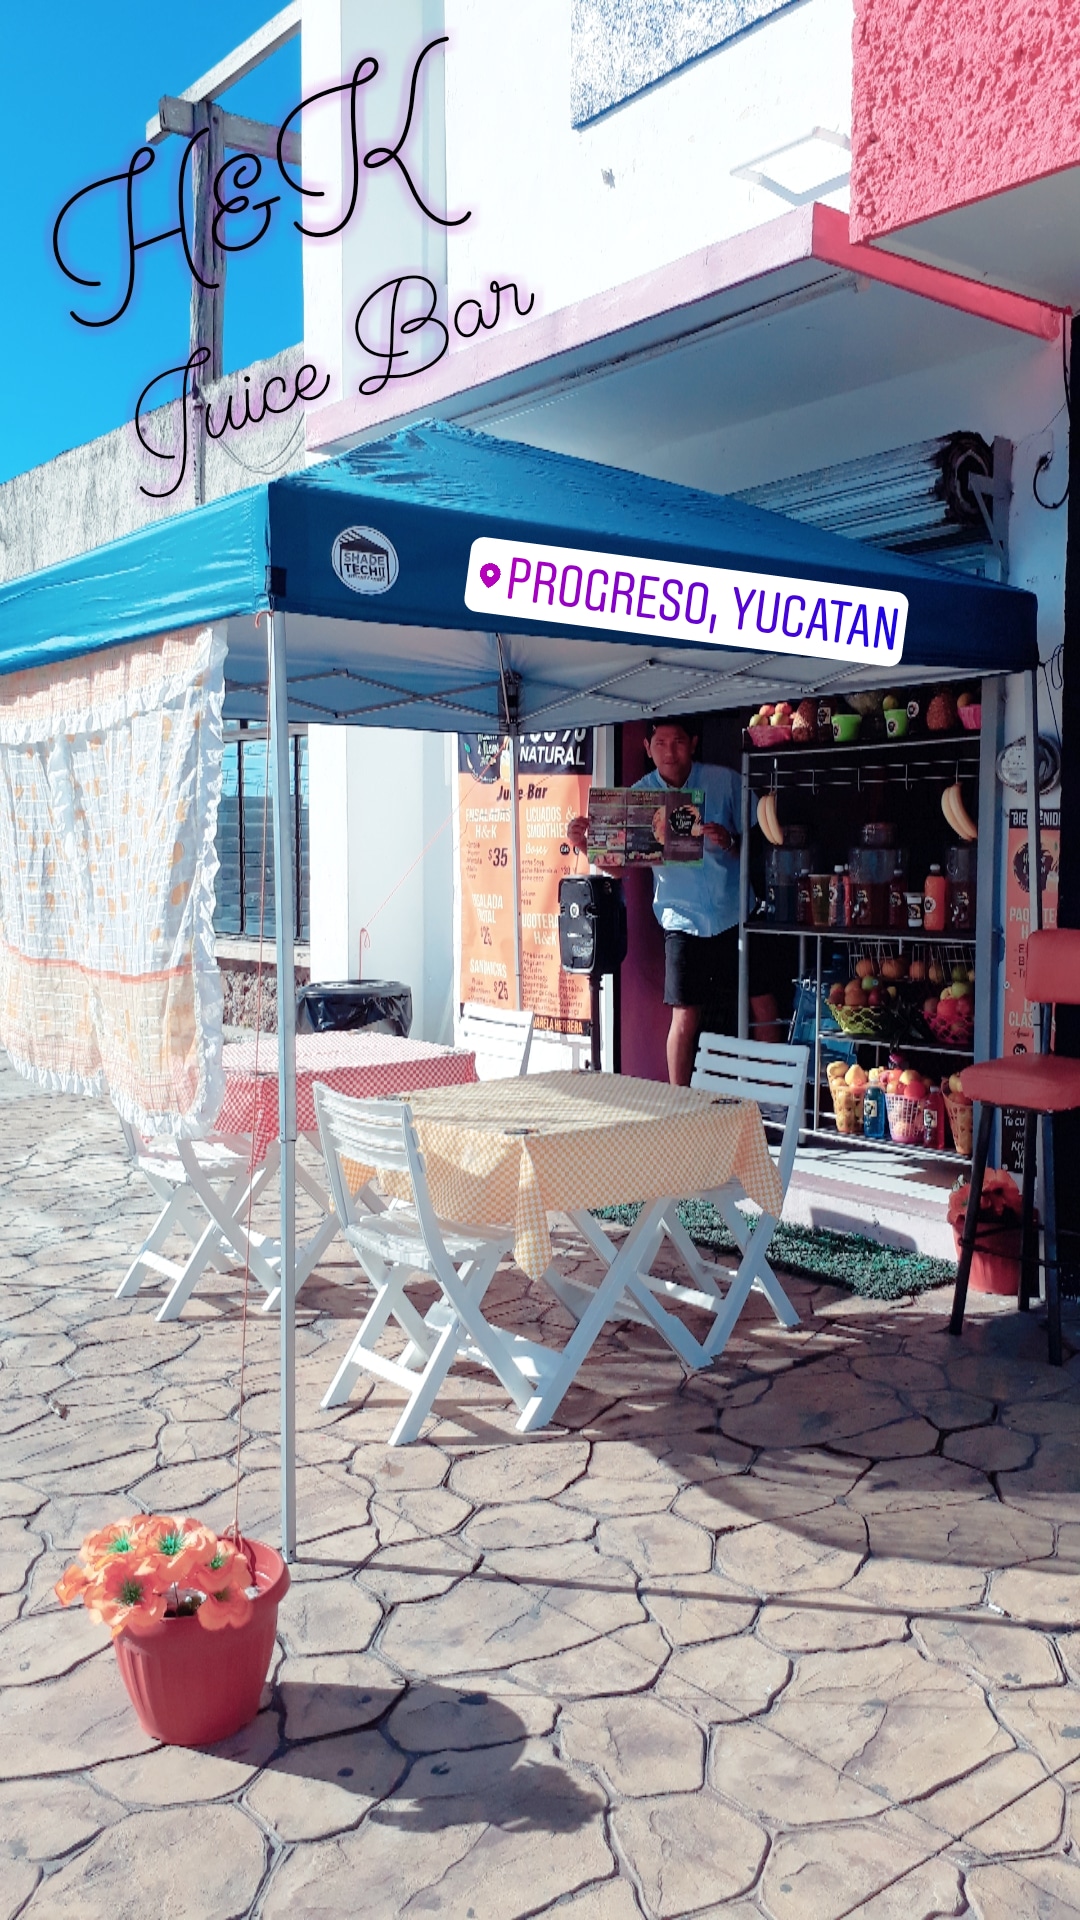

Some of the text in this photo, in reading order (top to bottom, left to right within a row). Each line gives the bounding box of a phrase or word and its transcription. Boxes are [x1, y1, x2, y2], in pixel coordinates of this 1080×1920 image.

[344, 552, 385, 566] SHADE
[519, 745, 586, 765] NATURAL
[497, 784, 548, 801] Jue Bar
[465, 808, 512, 823] ENSALADAS
[525, 806, 561, 822] LICUADOS
[475, 824, 498, 838] H&K
[526, 822, 568, 839] SMOOTHIES
[488, 847, 508, 867] $35
[1010, 907, 1056, 924] PAQTE
[534, 931, 557, 946] H&K
[493, 980, 509, 1001] $25
[554, 1018, 583, 1034] HERRERA
